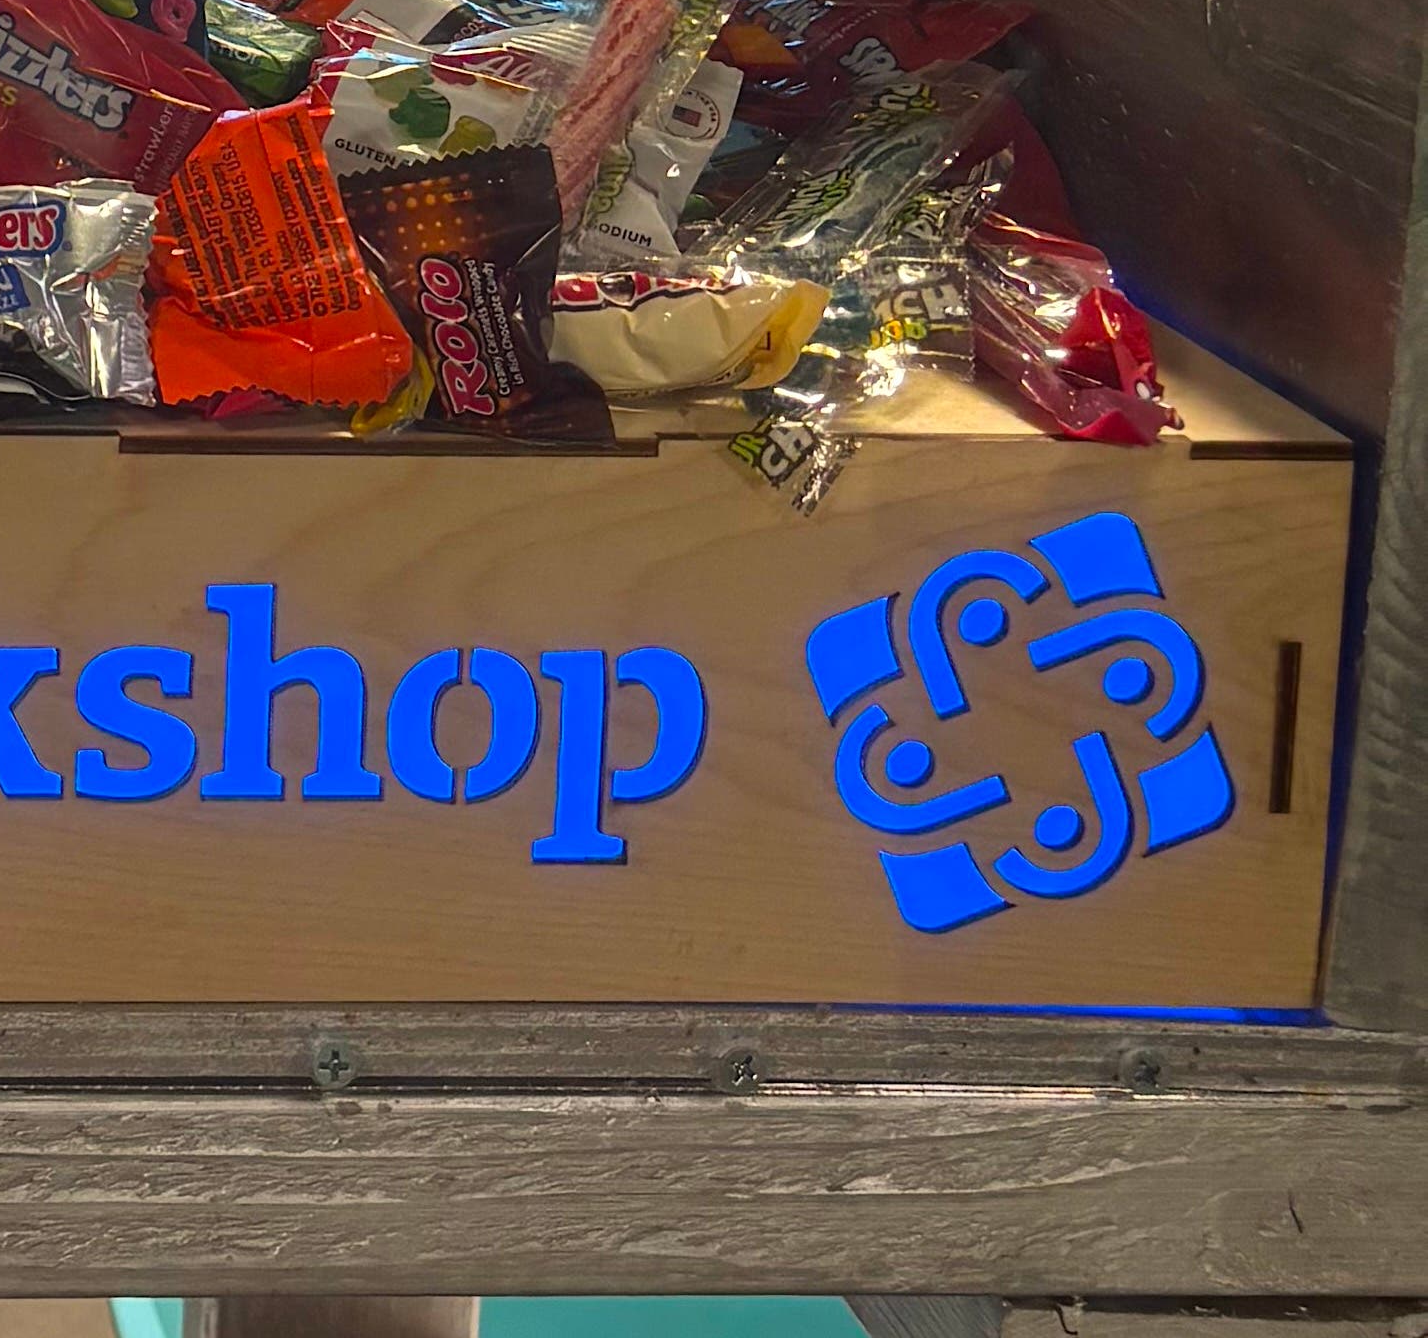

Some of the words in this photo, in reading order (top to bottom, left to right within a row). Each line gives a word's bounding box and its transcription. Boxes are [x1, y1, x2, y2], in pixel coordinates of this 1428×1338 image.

[335, 138, 396, 166] GLUTEN
[594, 222, 653, 248] ODIUM
[480, 261, 500, 295] Candy
[476, 306, 499, 355] Caramels
[490, 294, 514, 351] Chocolate
[491, 354, 511, 396] Creamy
